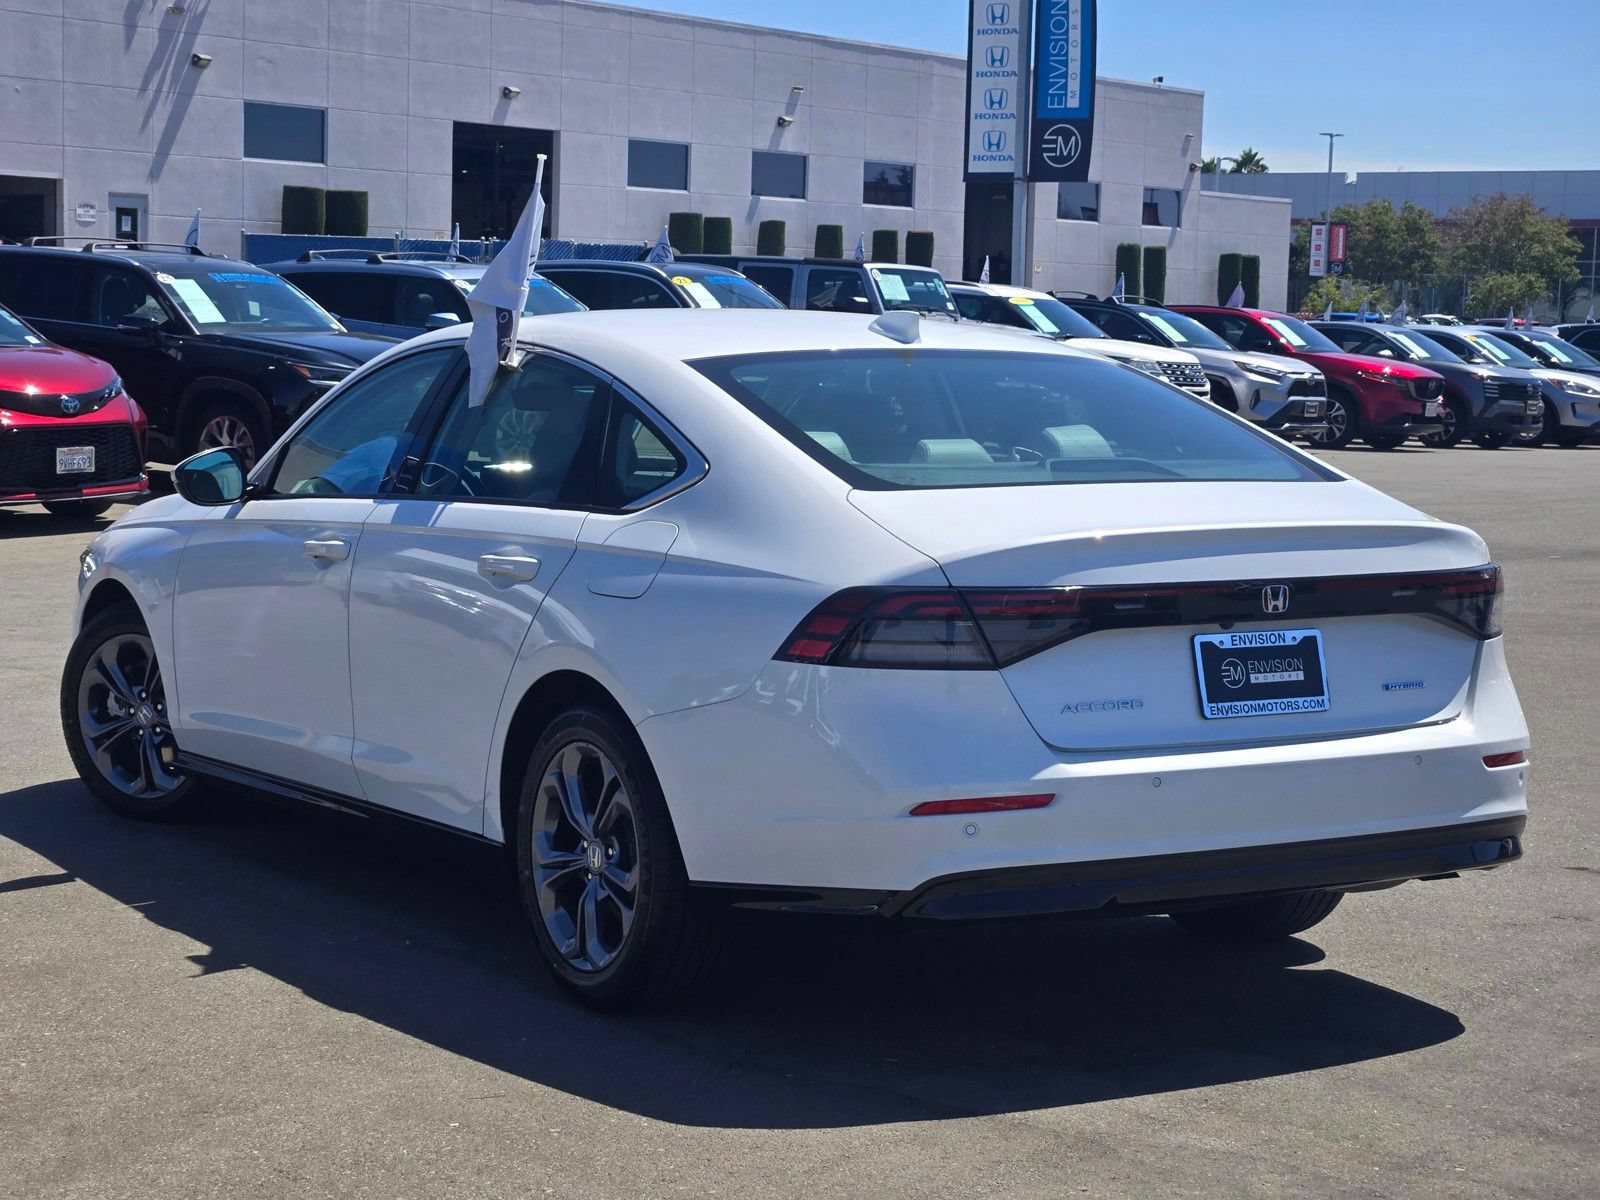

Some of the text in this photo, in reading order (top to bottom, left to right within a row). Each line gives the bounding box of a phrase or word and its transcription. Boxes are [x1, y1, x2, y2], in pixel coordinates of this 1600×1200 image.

[976, 28, 1019, 36] HONDA
[1048, 0, 1068, 108] ENVISION
[1070, 8, 1079, 99] MOTORS
[975, 70, 1018, 78] HONDA
[974, 112, 1017, 120] HONDA
[972, 154, 1015, 162] HONDA
[58, 456, 91, 469] 9VHF693
[1231, 633, 1286, 647] ENVISION
[1247, 658, 1304, 673] ENVISION
[1254, 673, 1300, 681] MOTORS
[1060, 699, 1144, 715] ACCORD
[1210, 698, 1326, 716] ENVISIONMOTORS.COM
